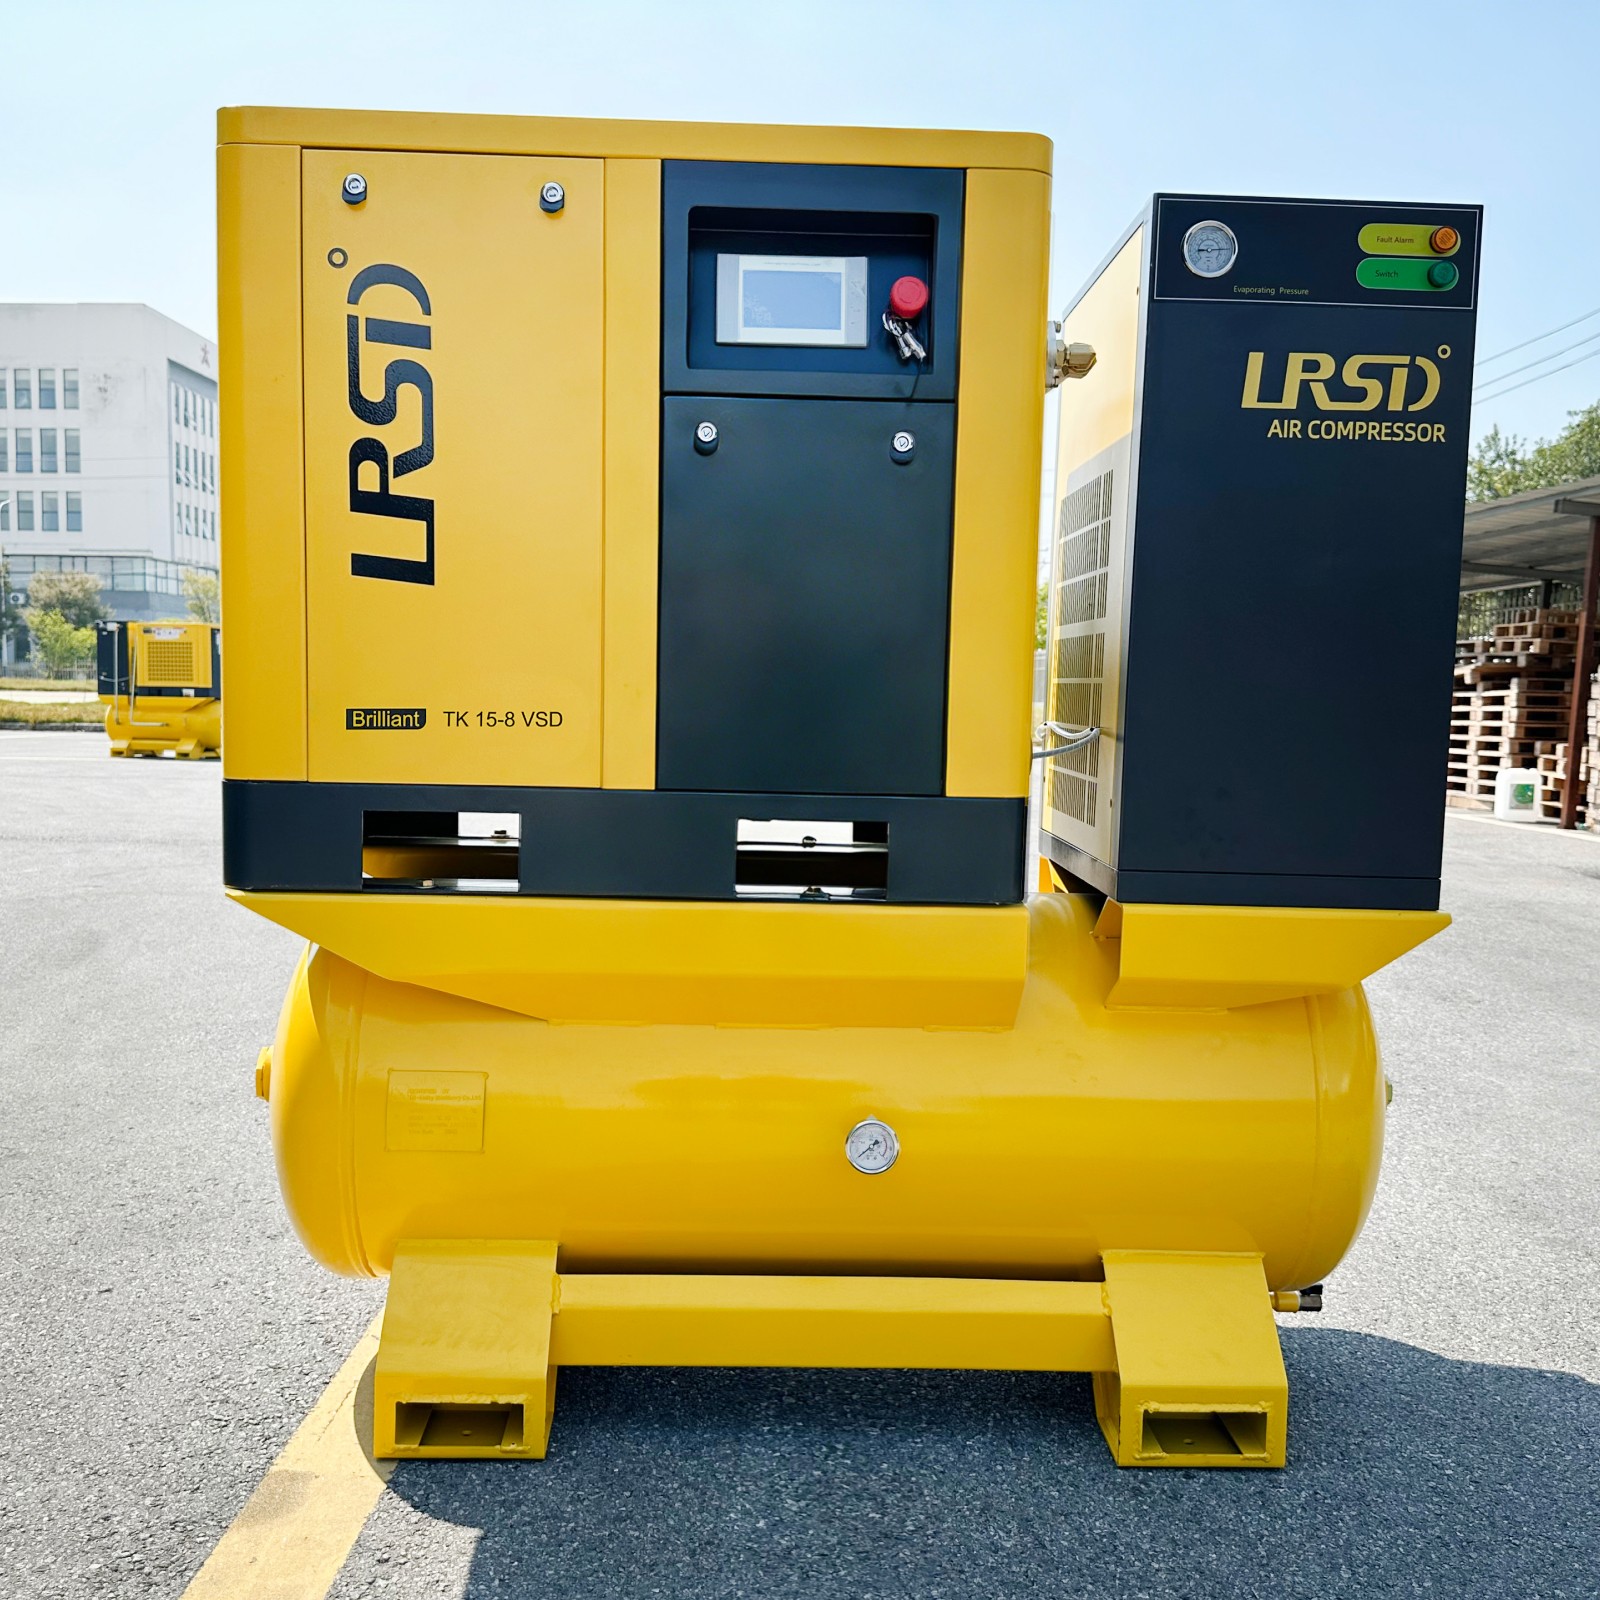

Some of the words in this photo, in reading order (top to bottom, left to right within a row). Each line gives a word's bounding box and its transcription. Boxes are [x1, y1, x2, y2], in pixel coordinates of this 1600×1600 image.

[1394, 236, 1414, 244] Alarm
[1375, 270, 1399, 278] Switch
[1233, 285, 1276, 296] Evaporating
[1279, 287, 1310, 295] Pressure
[1267, 419, 1301, 438] AIR
[1307, 420, 1446, 442] COMPRESSOR
[352, 710, 420, 728] Brilliant
[443, 711, 469, 727] TK
[476, 711, 516, 728] 15-8
[521, 711, 563, 728] VSD
